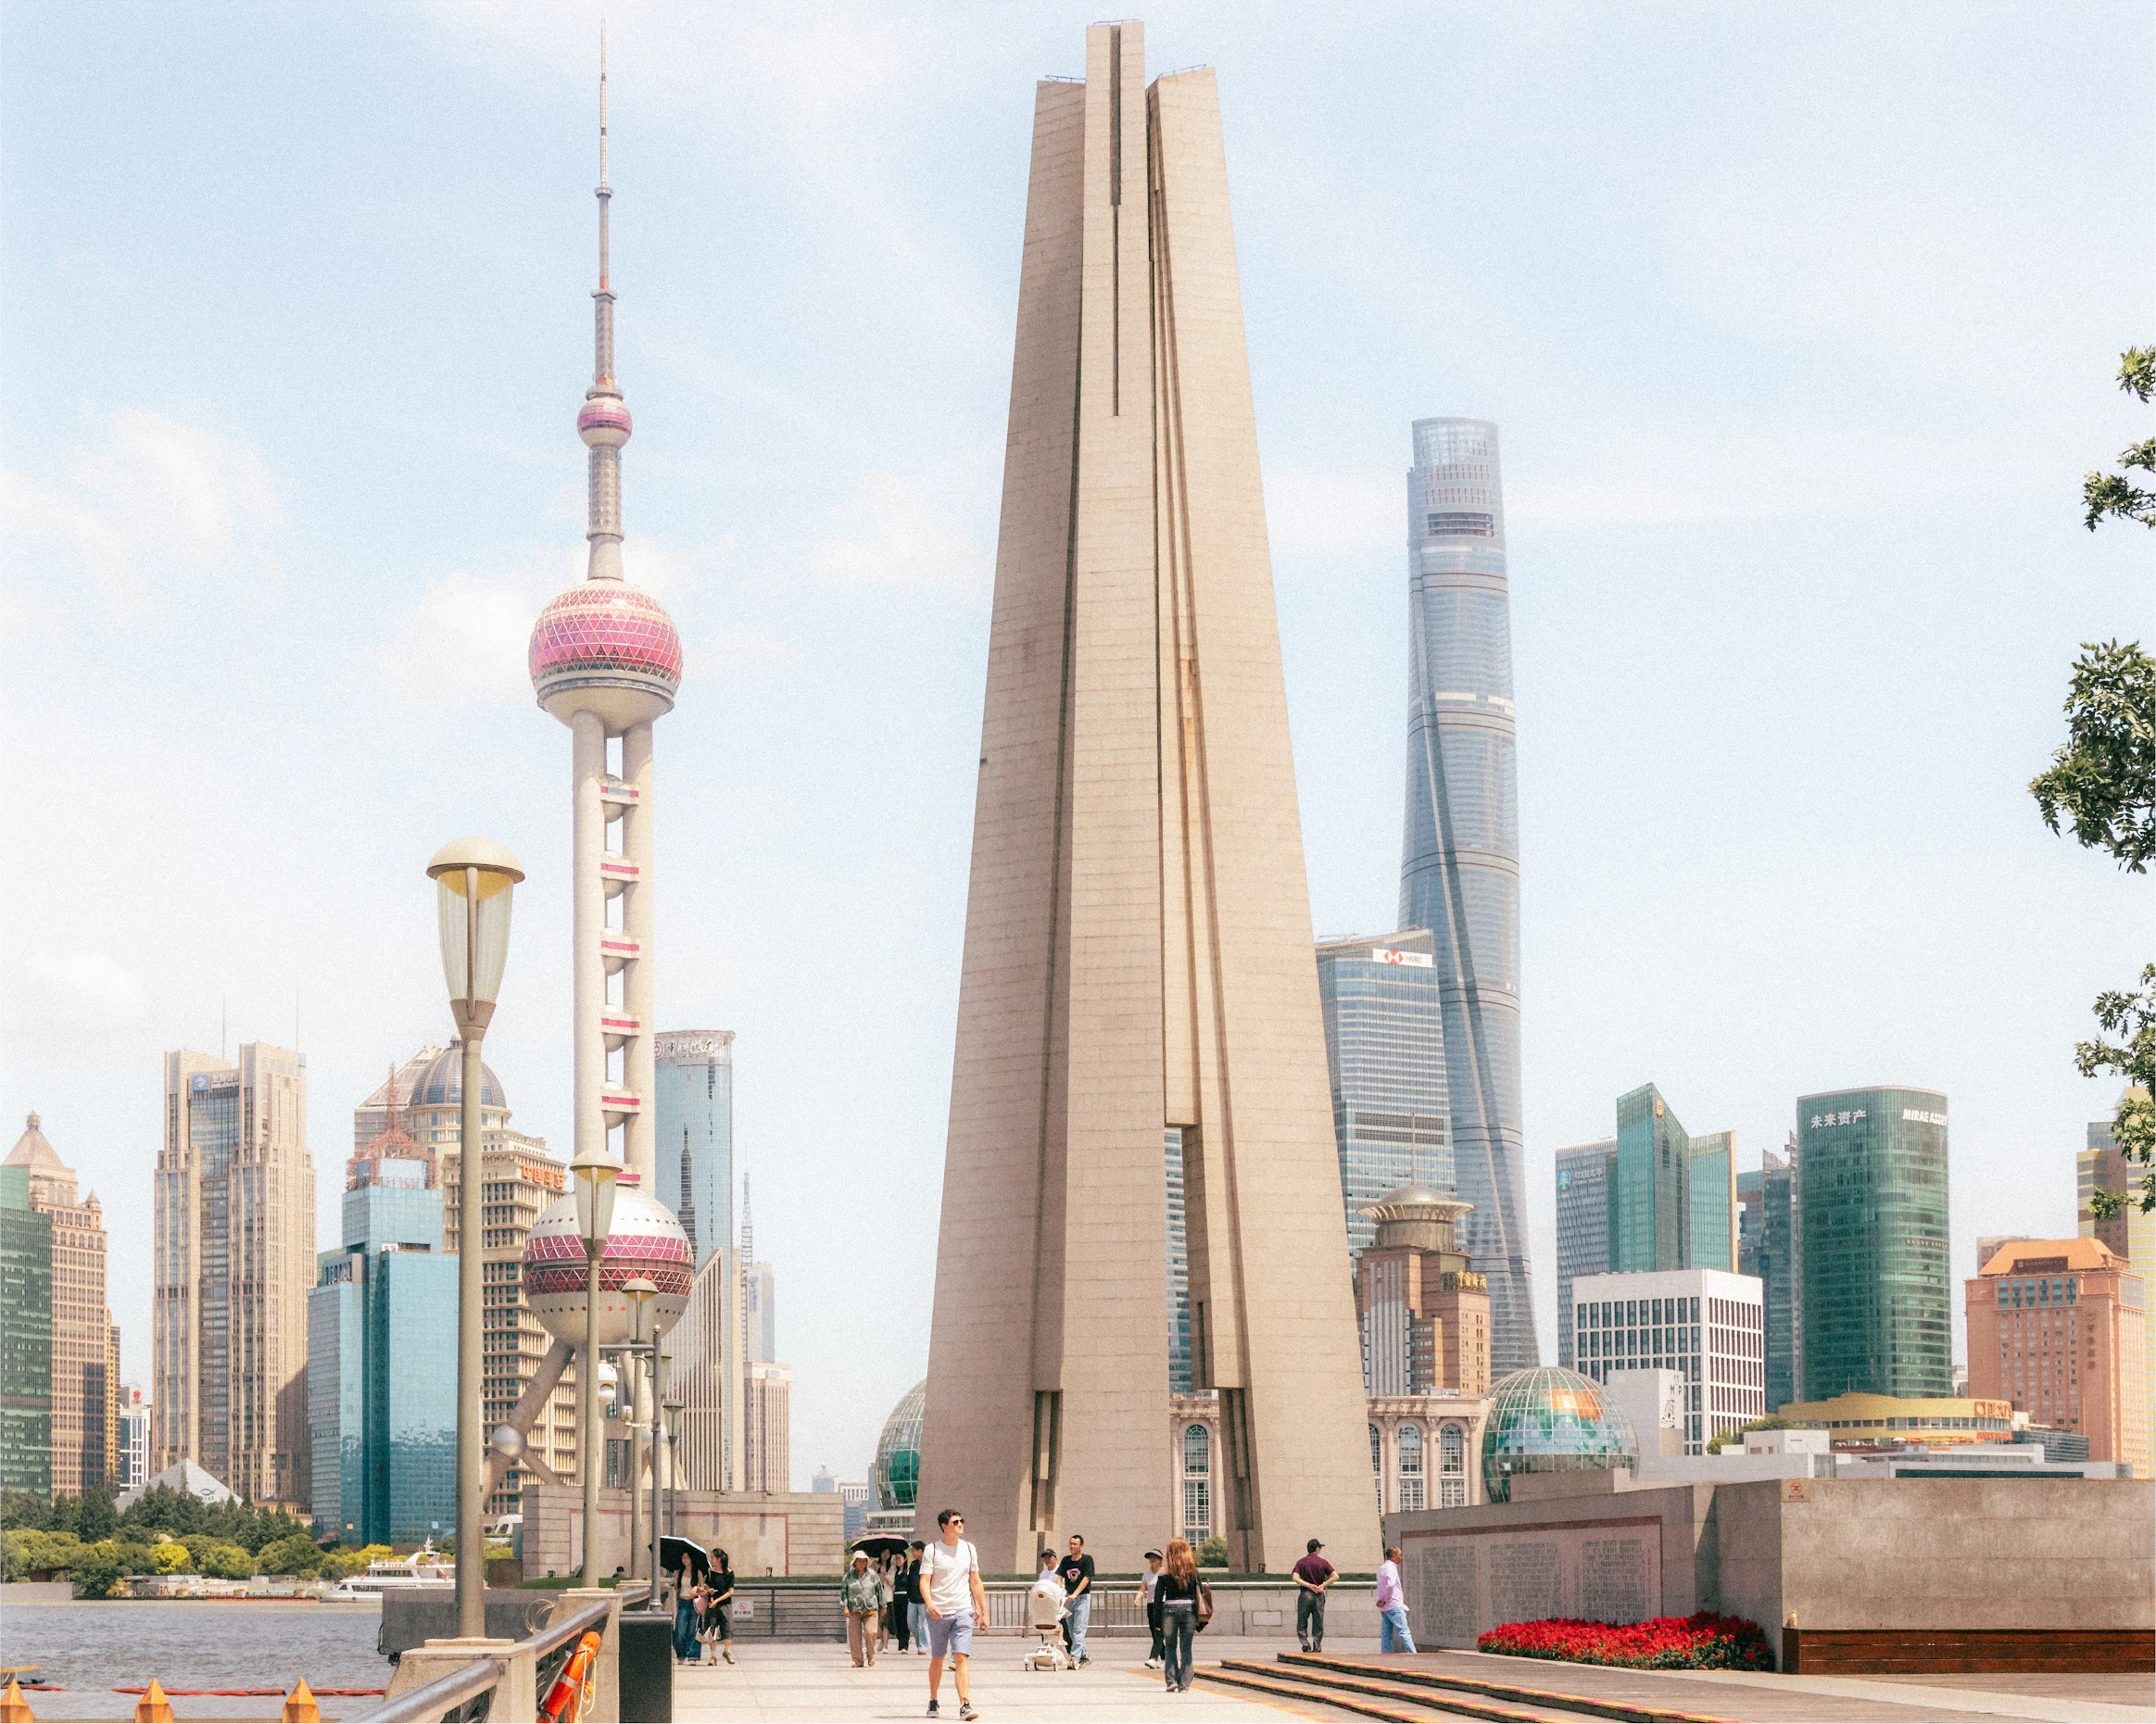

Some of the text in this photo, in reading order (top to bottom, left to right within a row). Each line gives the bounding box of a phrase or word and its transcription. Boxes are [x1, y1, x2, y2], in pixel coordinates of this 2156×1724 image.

[1405, 955, 1422, 963] HSBC
[1810, 1110, 1867, 1128] 未来资产
[1903, 1109, 1929, 1123] MIRAE
[522, 1164, 566, 1189] 中国平安
